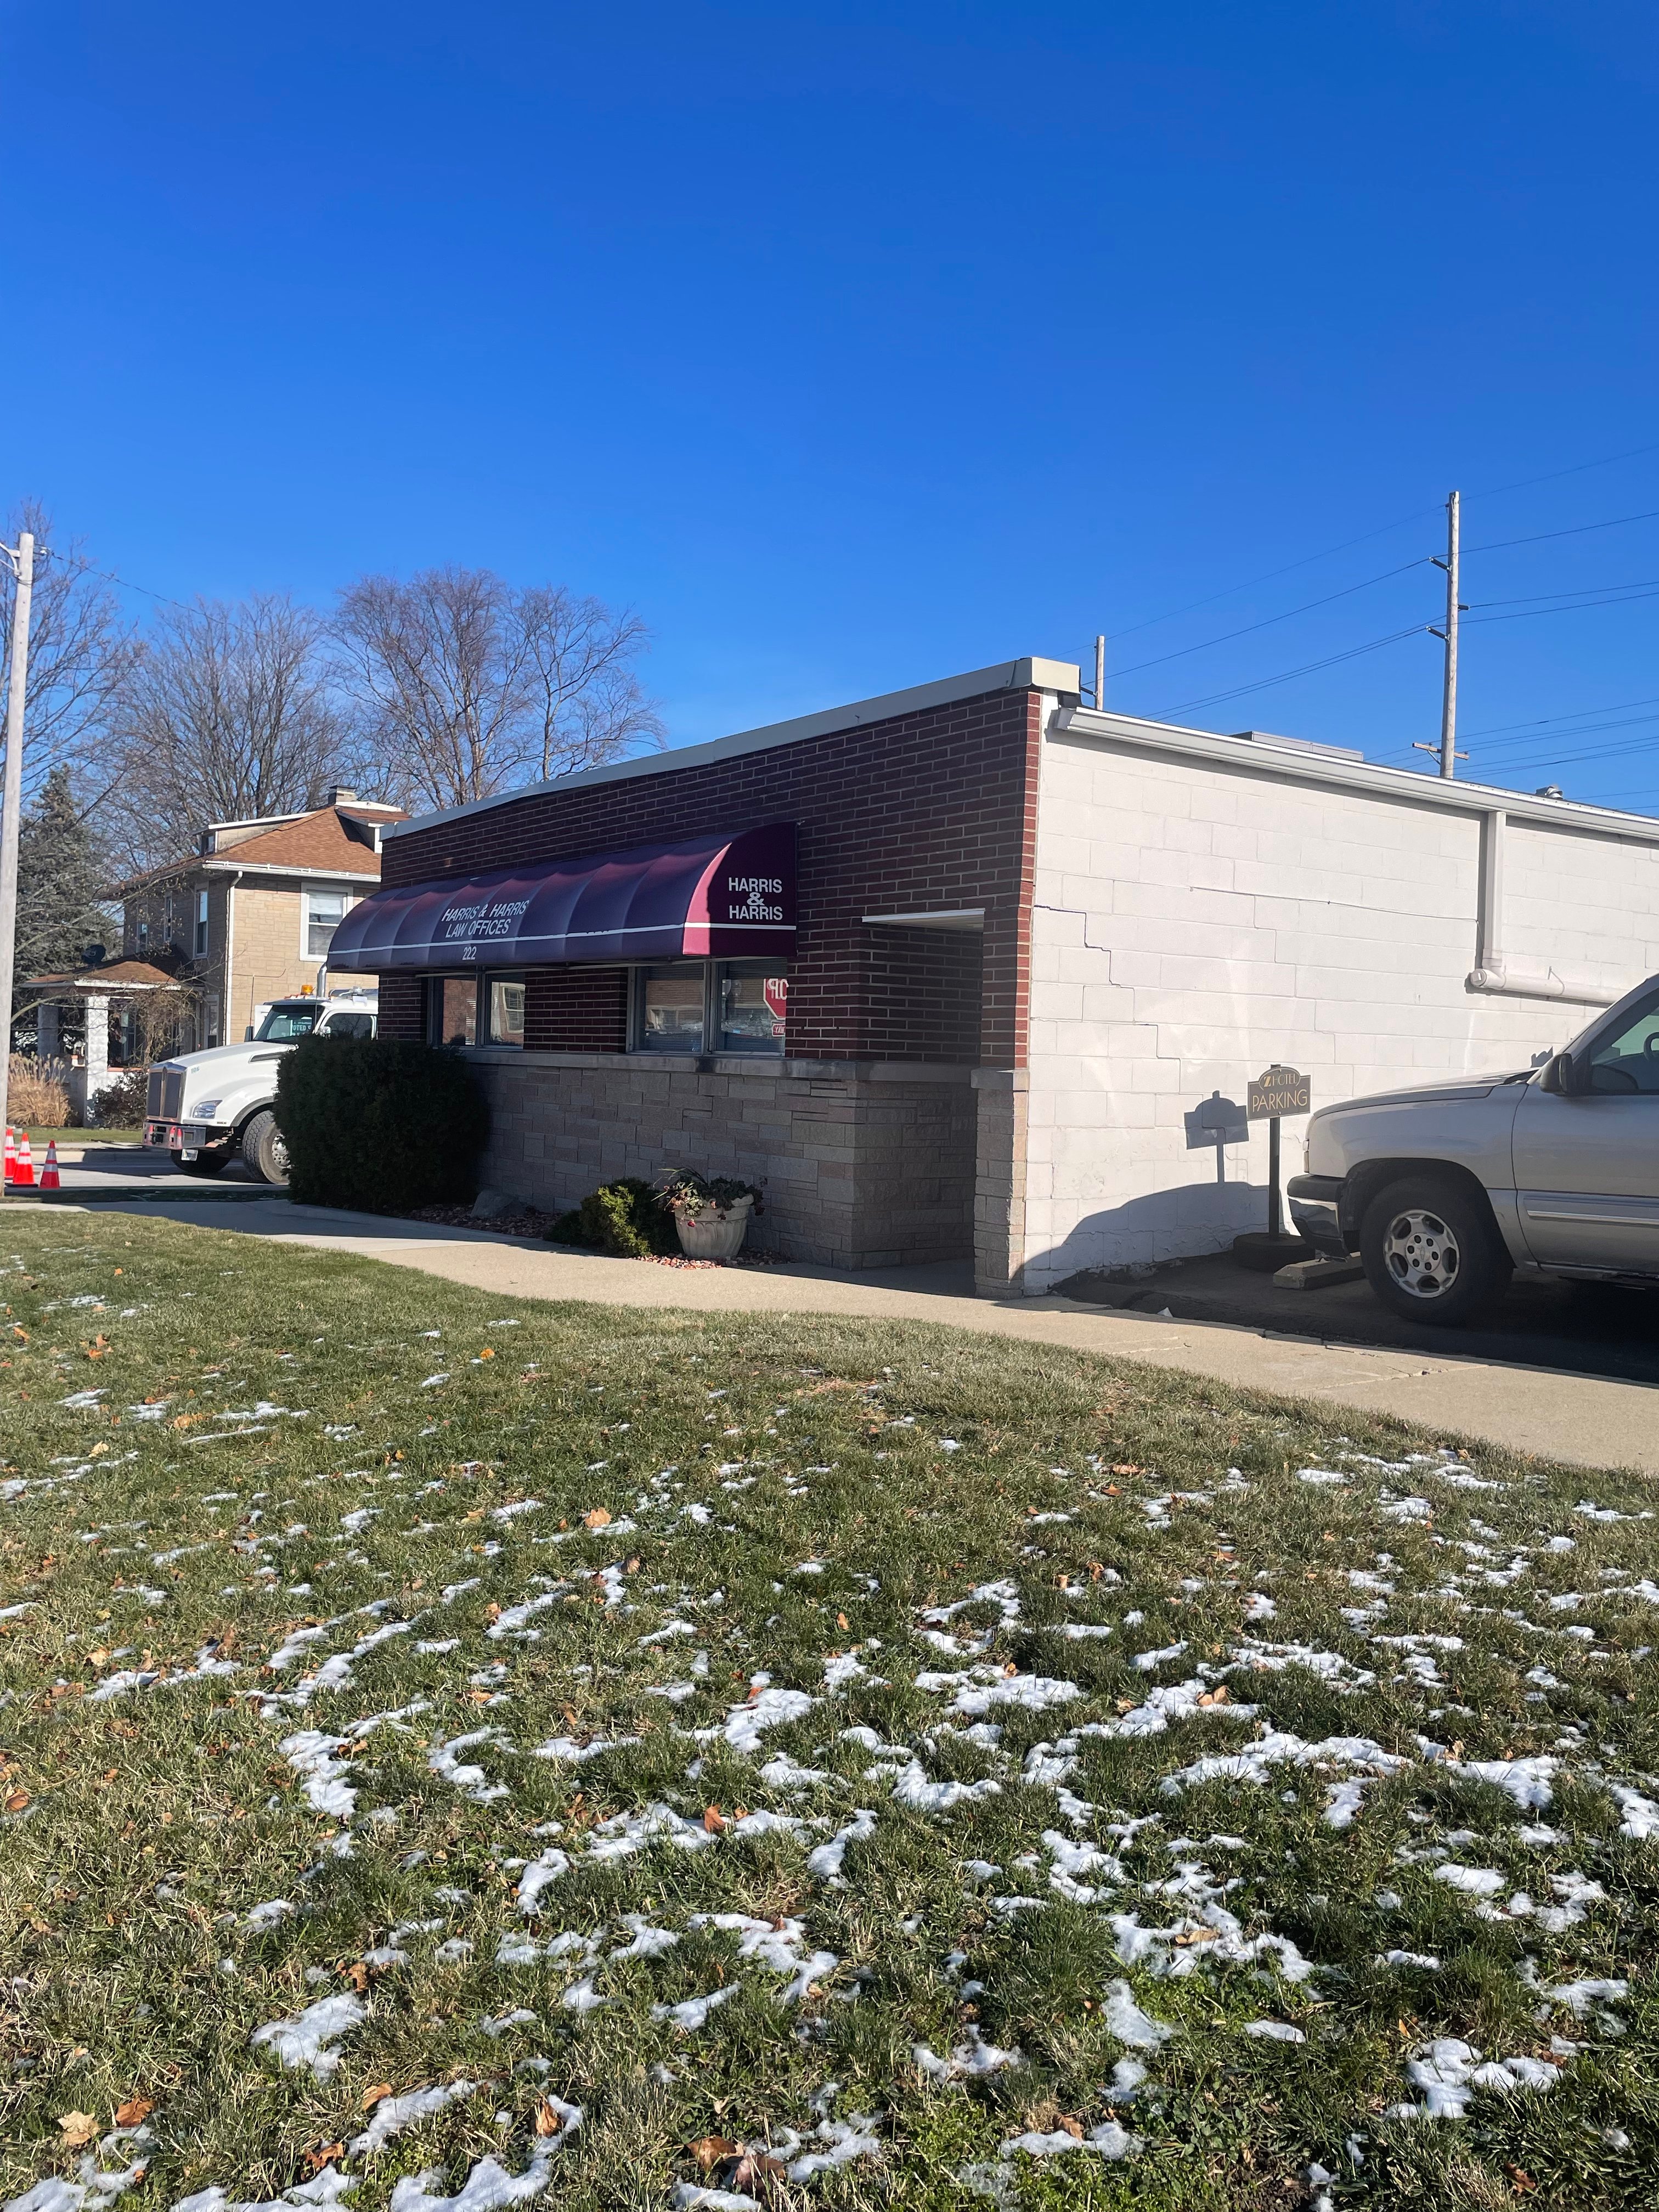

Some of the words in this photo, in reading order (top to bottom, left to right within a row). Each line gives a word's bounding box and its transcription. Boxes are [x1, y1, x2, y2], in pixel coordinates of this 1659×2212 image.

[729, 877, 782, 894] HARRIS
[747, 892, 765, 906] &
[442, 906, 480, 922] HARRIS
[478, 904, 488, 917] &
[489, 900, 530, 917] HARRIS
[729, 905, 783, 921] HARRIS
[445, 922, 469, 938] LAW
[468, 918, 511, 936] OFFICES
[462, 946, 477, 960] 222
[1263, 1076, 1271, 1087] Z
[1272, 1074, 1297, 1086] HOTEL
[1252, 1089, 1307, 1113] PARKING
